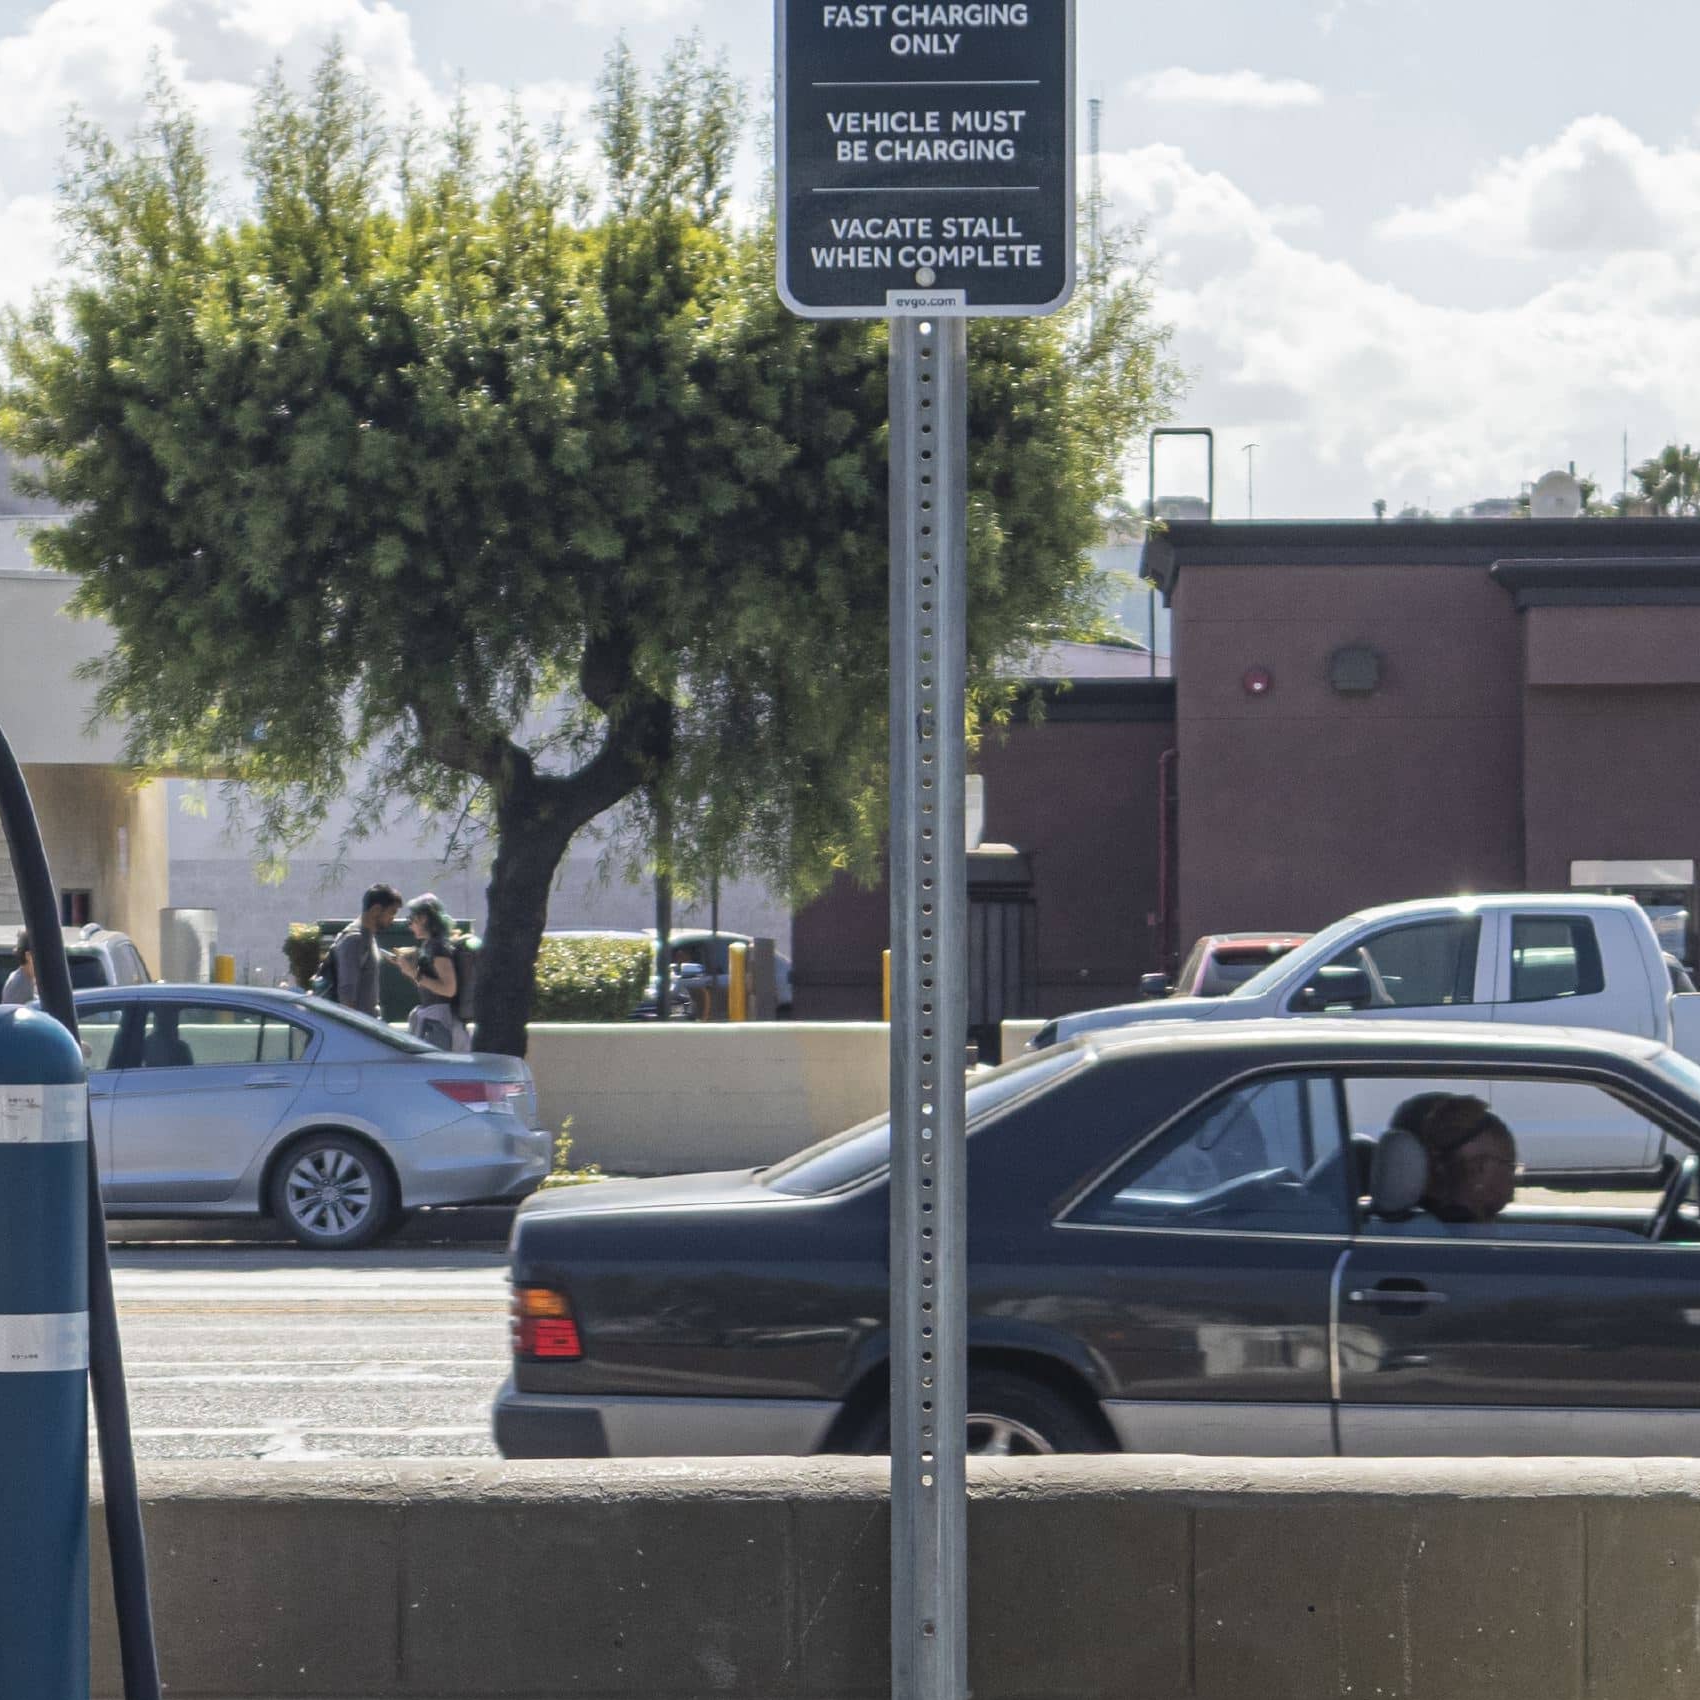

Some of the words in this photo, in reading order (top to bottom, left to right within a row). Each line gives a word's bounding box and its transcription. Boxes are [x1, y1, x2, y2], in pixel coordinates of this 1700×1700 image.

[823, 5, 886, 28] FAST
[891, 3, 1029, 27] CHARGING
[889, 33, 961, 56] ONLY
[827, 111, 941, 134] VEHICLE
[951, 110, 1026, 133] MUST
[836, 141, 869, 162] BE
[874, 139, 1016, 162] CHARGING
[831, 217, 933, 239] VACATE
[941, 217, 1023, 238] STALL
[811, 246, 892, 268] WHEN
[898, 245, 1043, 267] COMPLETE
[896, 298, 957, 309] evgo.com
